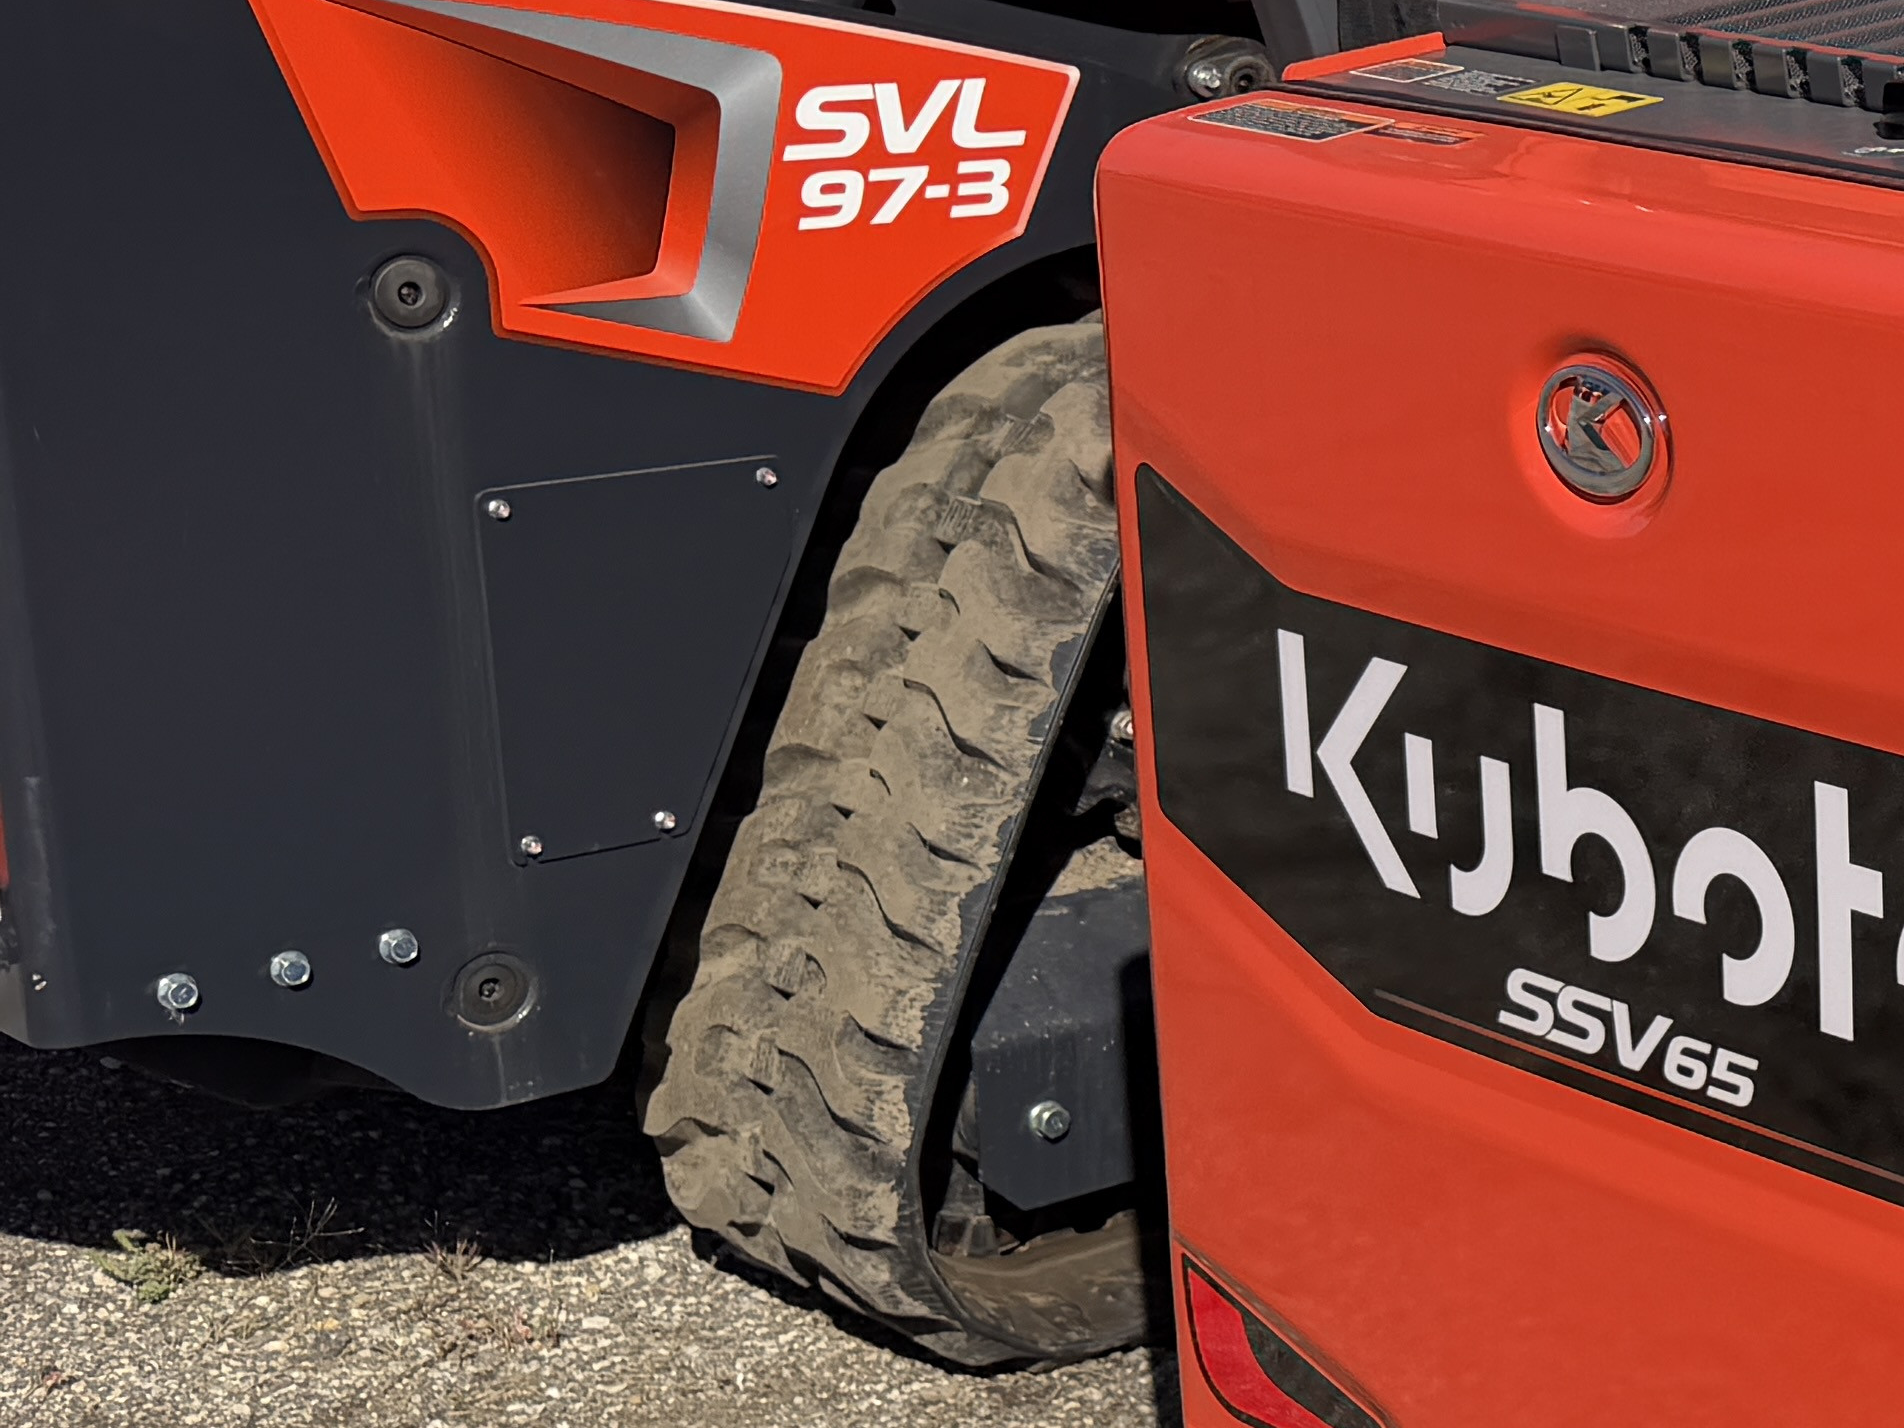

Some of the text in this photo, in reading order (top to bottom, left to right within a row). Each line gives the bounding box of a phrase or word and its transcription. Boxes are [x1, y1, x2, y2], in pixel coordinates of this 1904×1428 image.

[782, 77, 1027, 162] SVL
[798, 157, 1011, 232] 97-3
[1497, 967, 1760, 1108] SSV65
